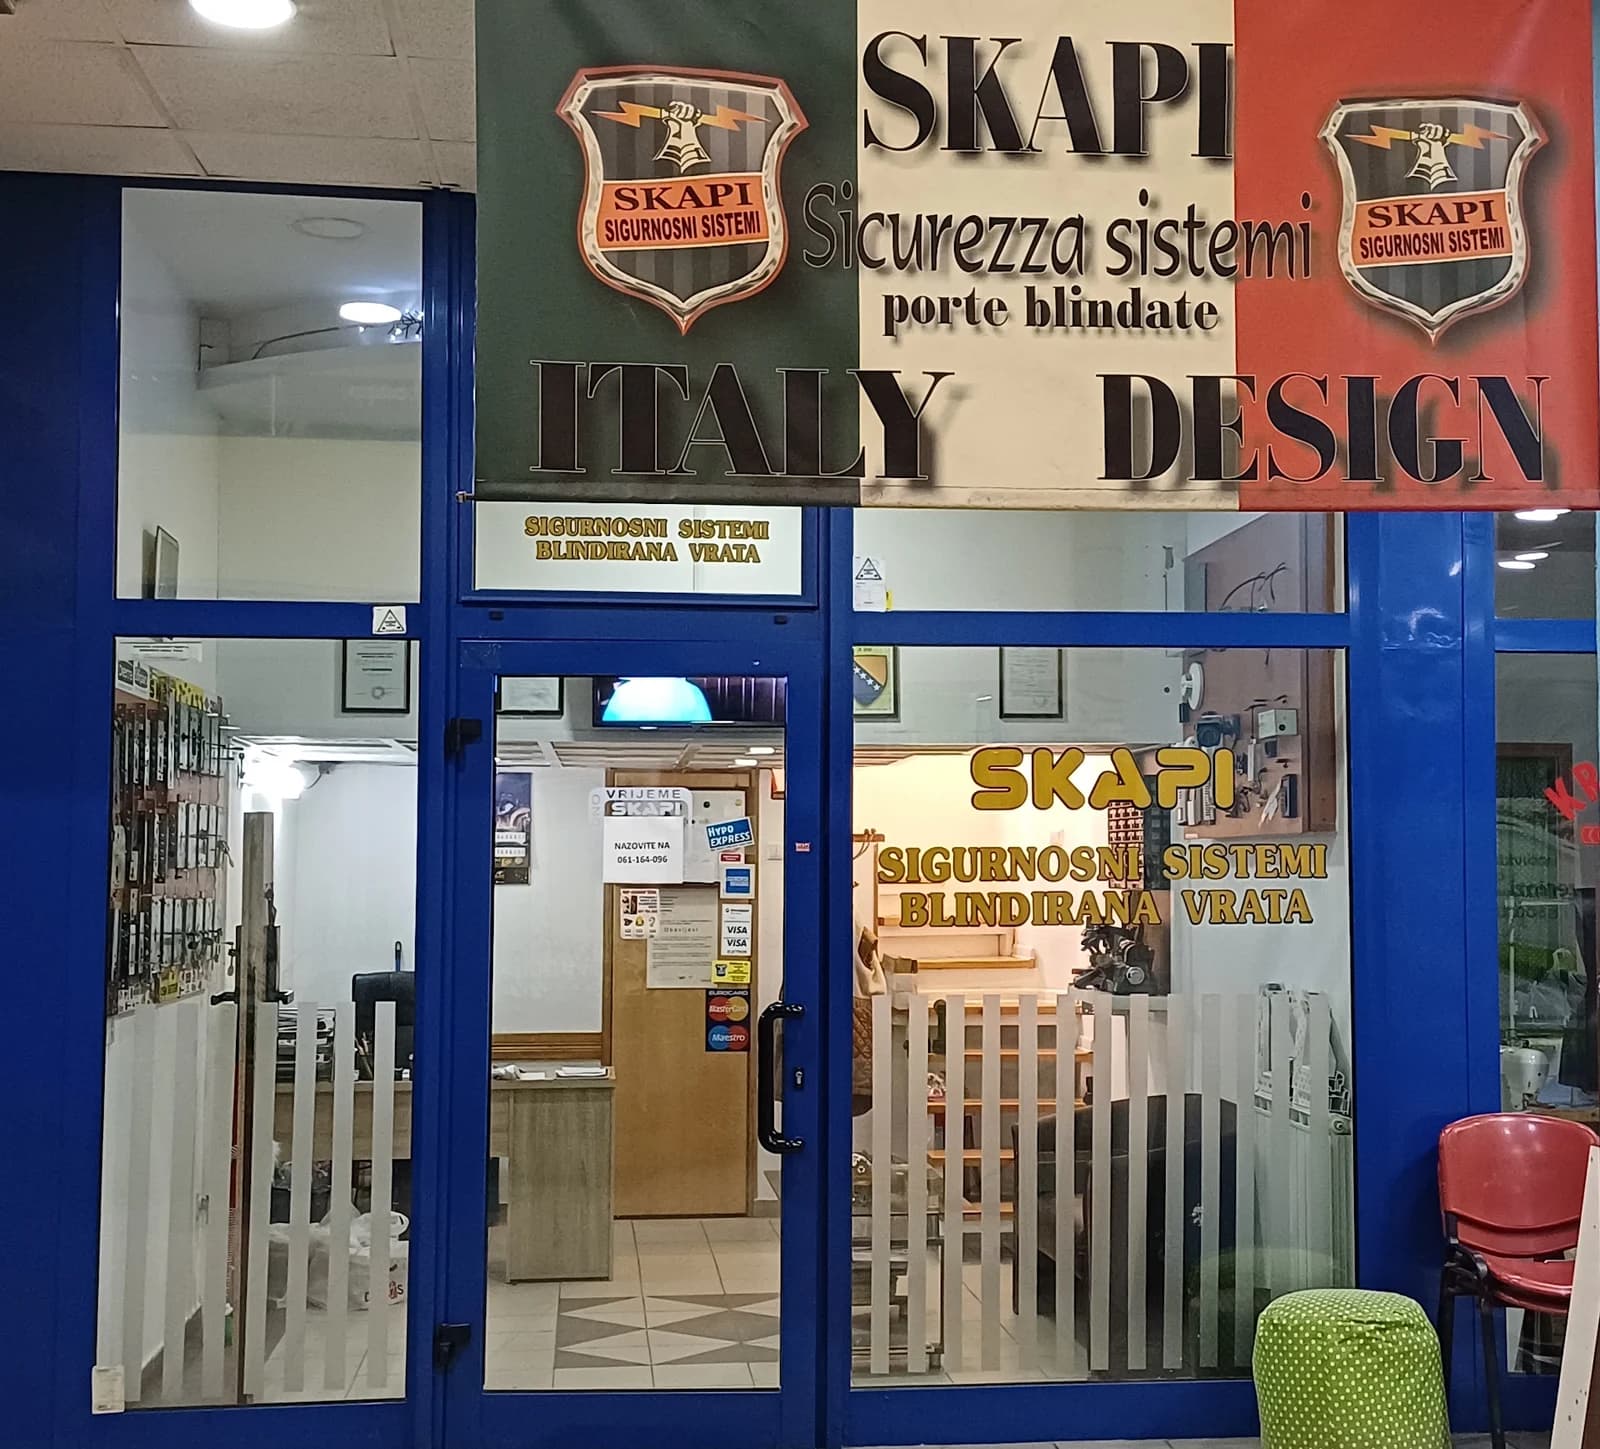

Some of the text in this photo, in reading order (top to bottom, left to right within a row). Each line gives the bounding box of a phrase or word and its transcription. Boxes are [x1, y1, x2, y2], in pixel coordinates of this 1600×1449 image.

[862, 31, 1234, 157] SKAPI
[614, 182, 753, 211] SKAPI
[605, 210, 761, 242] SIGURNOSNI SISTEMI
[1367, 199, 1497, 228] SKAPI
[803, 182, 1312, 279] Sicurezza sistemi
[1359, 226, 1505, 259] SIGURNOSNI SISTEMI
[882, 285, 1218, 336] porte blindate
[529, 359, 1550, 482] ITALY DESIGN
[525, 516, 770, 539] SIGURNOSNI SISTEMI
[536, 540, 761, 563] BLINDIRANA VRATA
[970, 747, 1235, 810] SKAPI
[606, 789, 681, 799] VRIJEME
[614, 841, 670, 850] NAZOVITE NA
[707, 825, 734, 838] HYPO
[710, 831, 750, 847] EXPRESS
[617, 855, 668, 864] 061-164-096
[878, 844, 1328, 883] SIGURNOSNI SISTEMI
[899, 889, 1314, 927] BLINDIRANA VRATA
[727, 926, 747, 934] VISA
[727, 939, 747, 947] VISA
[711, 1034, 745, 1042] Maestro
